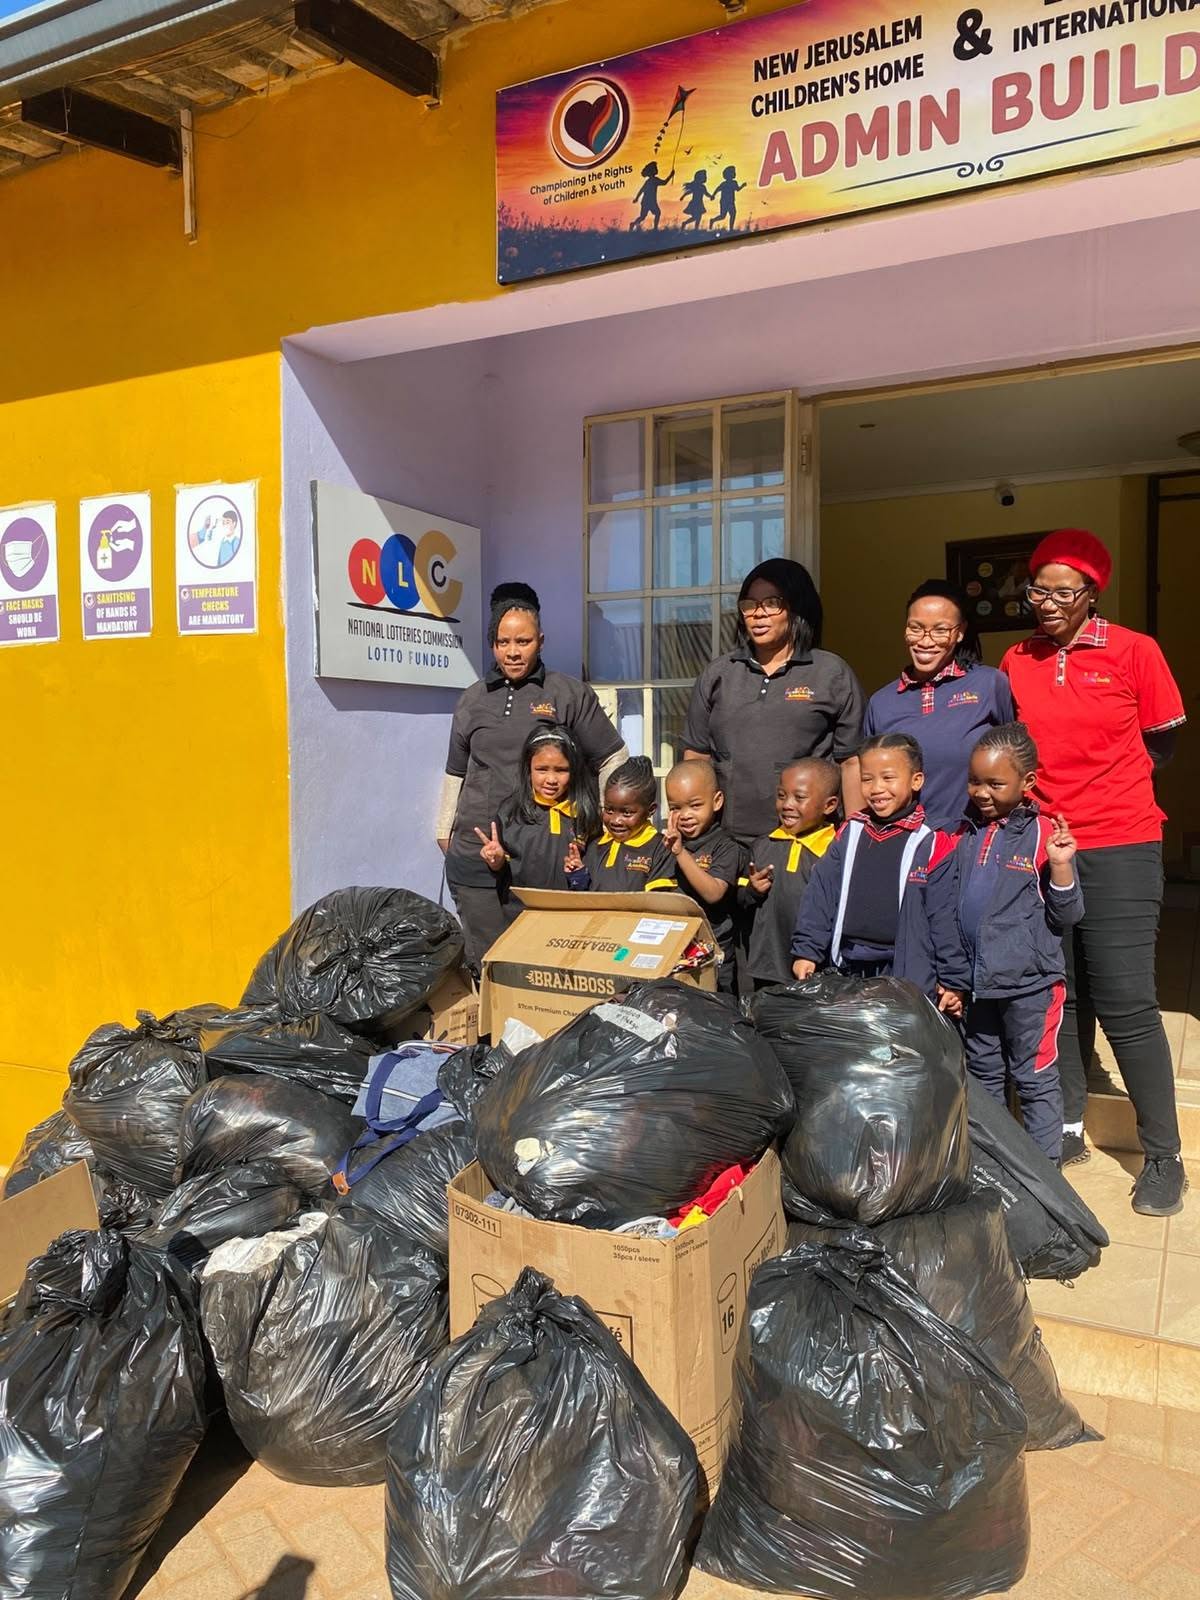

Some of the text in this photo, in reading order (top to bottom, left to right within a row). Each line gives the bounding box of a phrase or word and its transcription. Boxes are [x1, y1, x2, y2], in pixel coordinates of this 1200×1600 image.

[953, 8, 993, 61] &
[753, 15, 923, 82] NEW JERUSALEM
[751, 53, 924, 117] CHILDREN'S HOME
[758, 31, 1200, 187] ADMIN BUILD
[530, 165, 633, 195] Championing the Rights
[543, 179, 625, 205] of Children & Youth
[96, 592, 136, 605] SANITISING
[191, 586, 239, 599] TEMPERATURE
[5, 598, 44, 611] FACE MASKS
[96, 606, 138, 619] OF HANDS IS
[201, 600, 230, 612] CHECKS
[8, 612, 43, 624] SHOULD BE
[96, 620, 138, 633] MANDATORY
[188, 613, 245, 625] ARE MANDATORY
[348, 618, 464, 649] NATIONAL LOTTERIES COMMISSION
[368, 645, 449, 668] LOTTO FUNDED
[546, 937, 618, 953] BRAAIBOSS
[534, 970, 615, 994] BRAAIBOSS
[534, 1005, 562, 1016] Premium
[455, 1204, 496, 1233] 07302-111
[722, 1304, 735, 1335] 16
